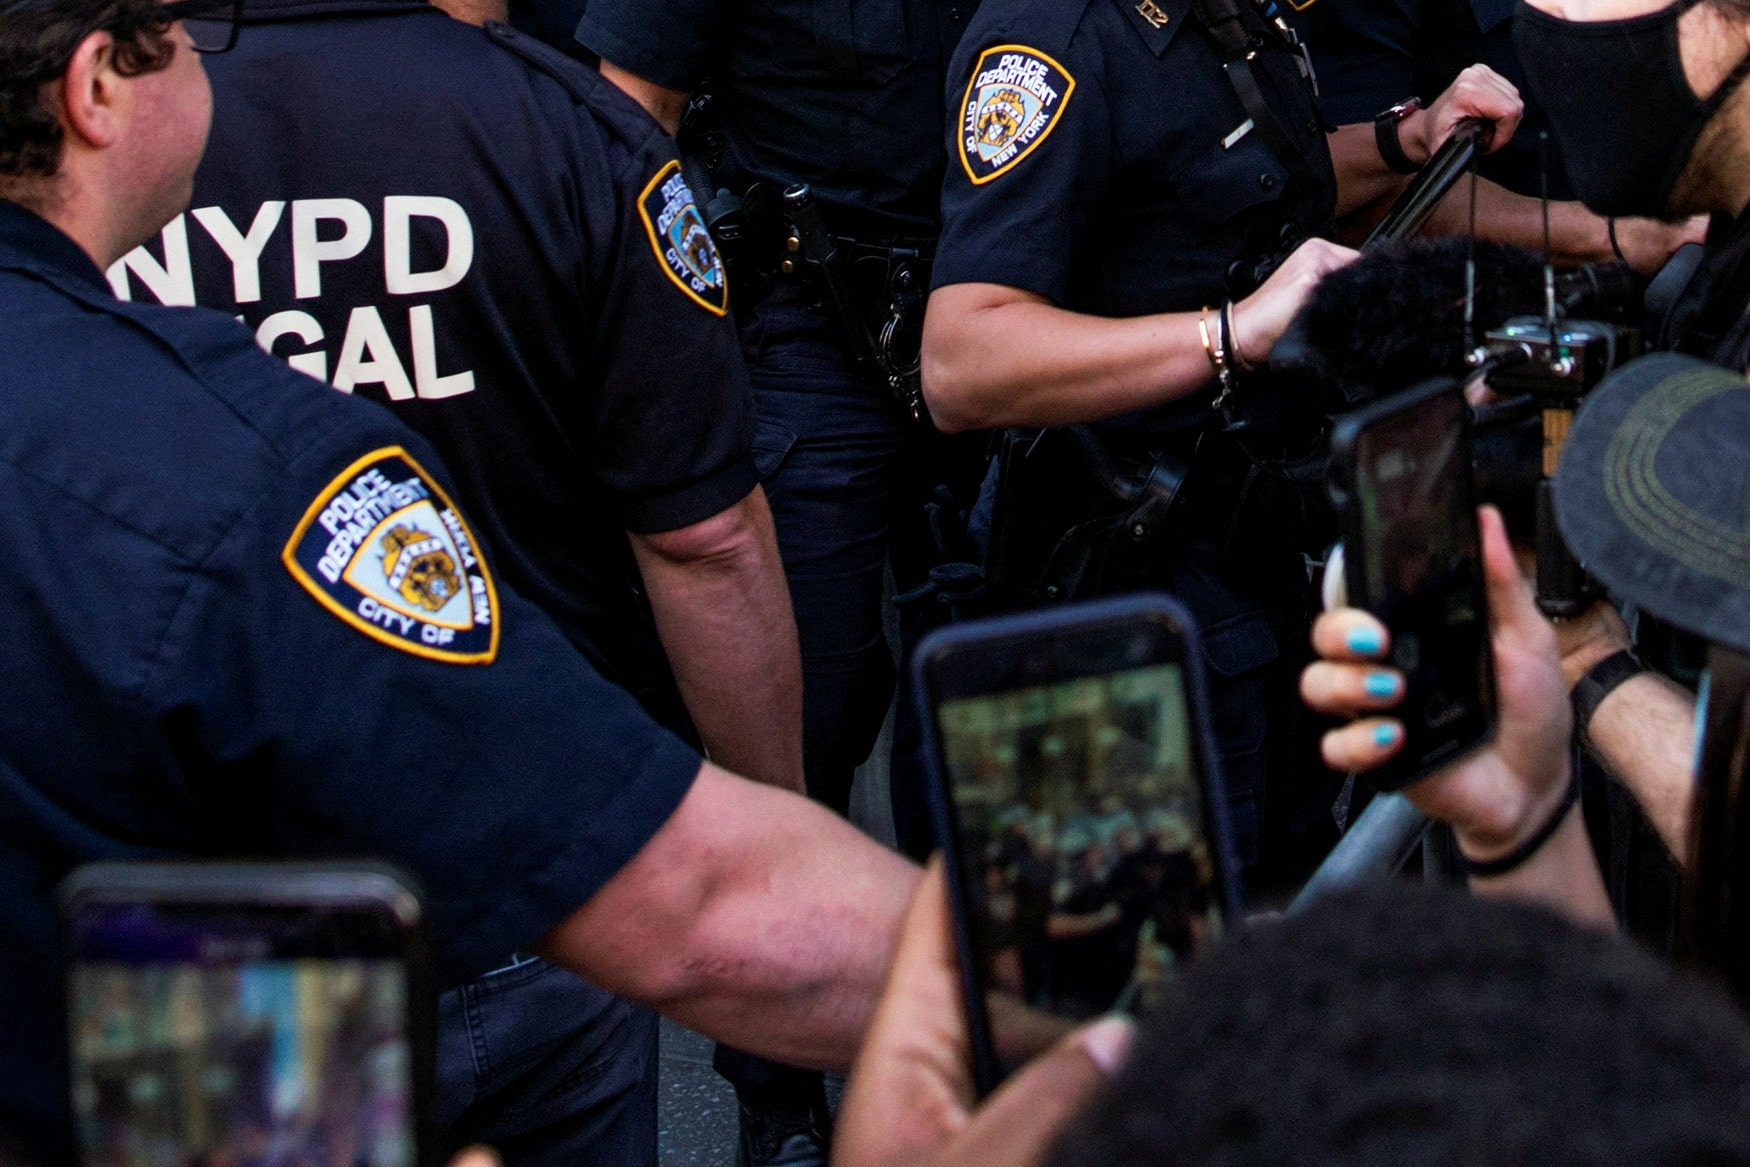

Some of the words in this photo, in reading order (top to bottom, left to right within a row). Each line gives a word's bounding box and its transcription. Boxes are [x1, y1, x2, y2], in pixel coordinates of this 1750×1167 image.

[998, 54, 1049, 79] POLICE
[975, 68, 1058, 107] DEPARTMENT
[964, 100, 978, 132] CITY
[965, 135, 978, 154] OF
[991, 143, 1018, 168] NEW
[1017, 110, 1050, 145] YORK
[107, 194, 475, 308] NYPD
[665, 247, 691, 278] CITY
[318, 468, 392, 536] POLICE
[357, 596, 417, 636] CITY
[420, 622, 456, 645] OF
